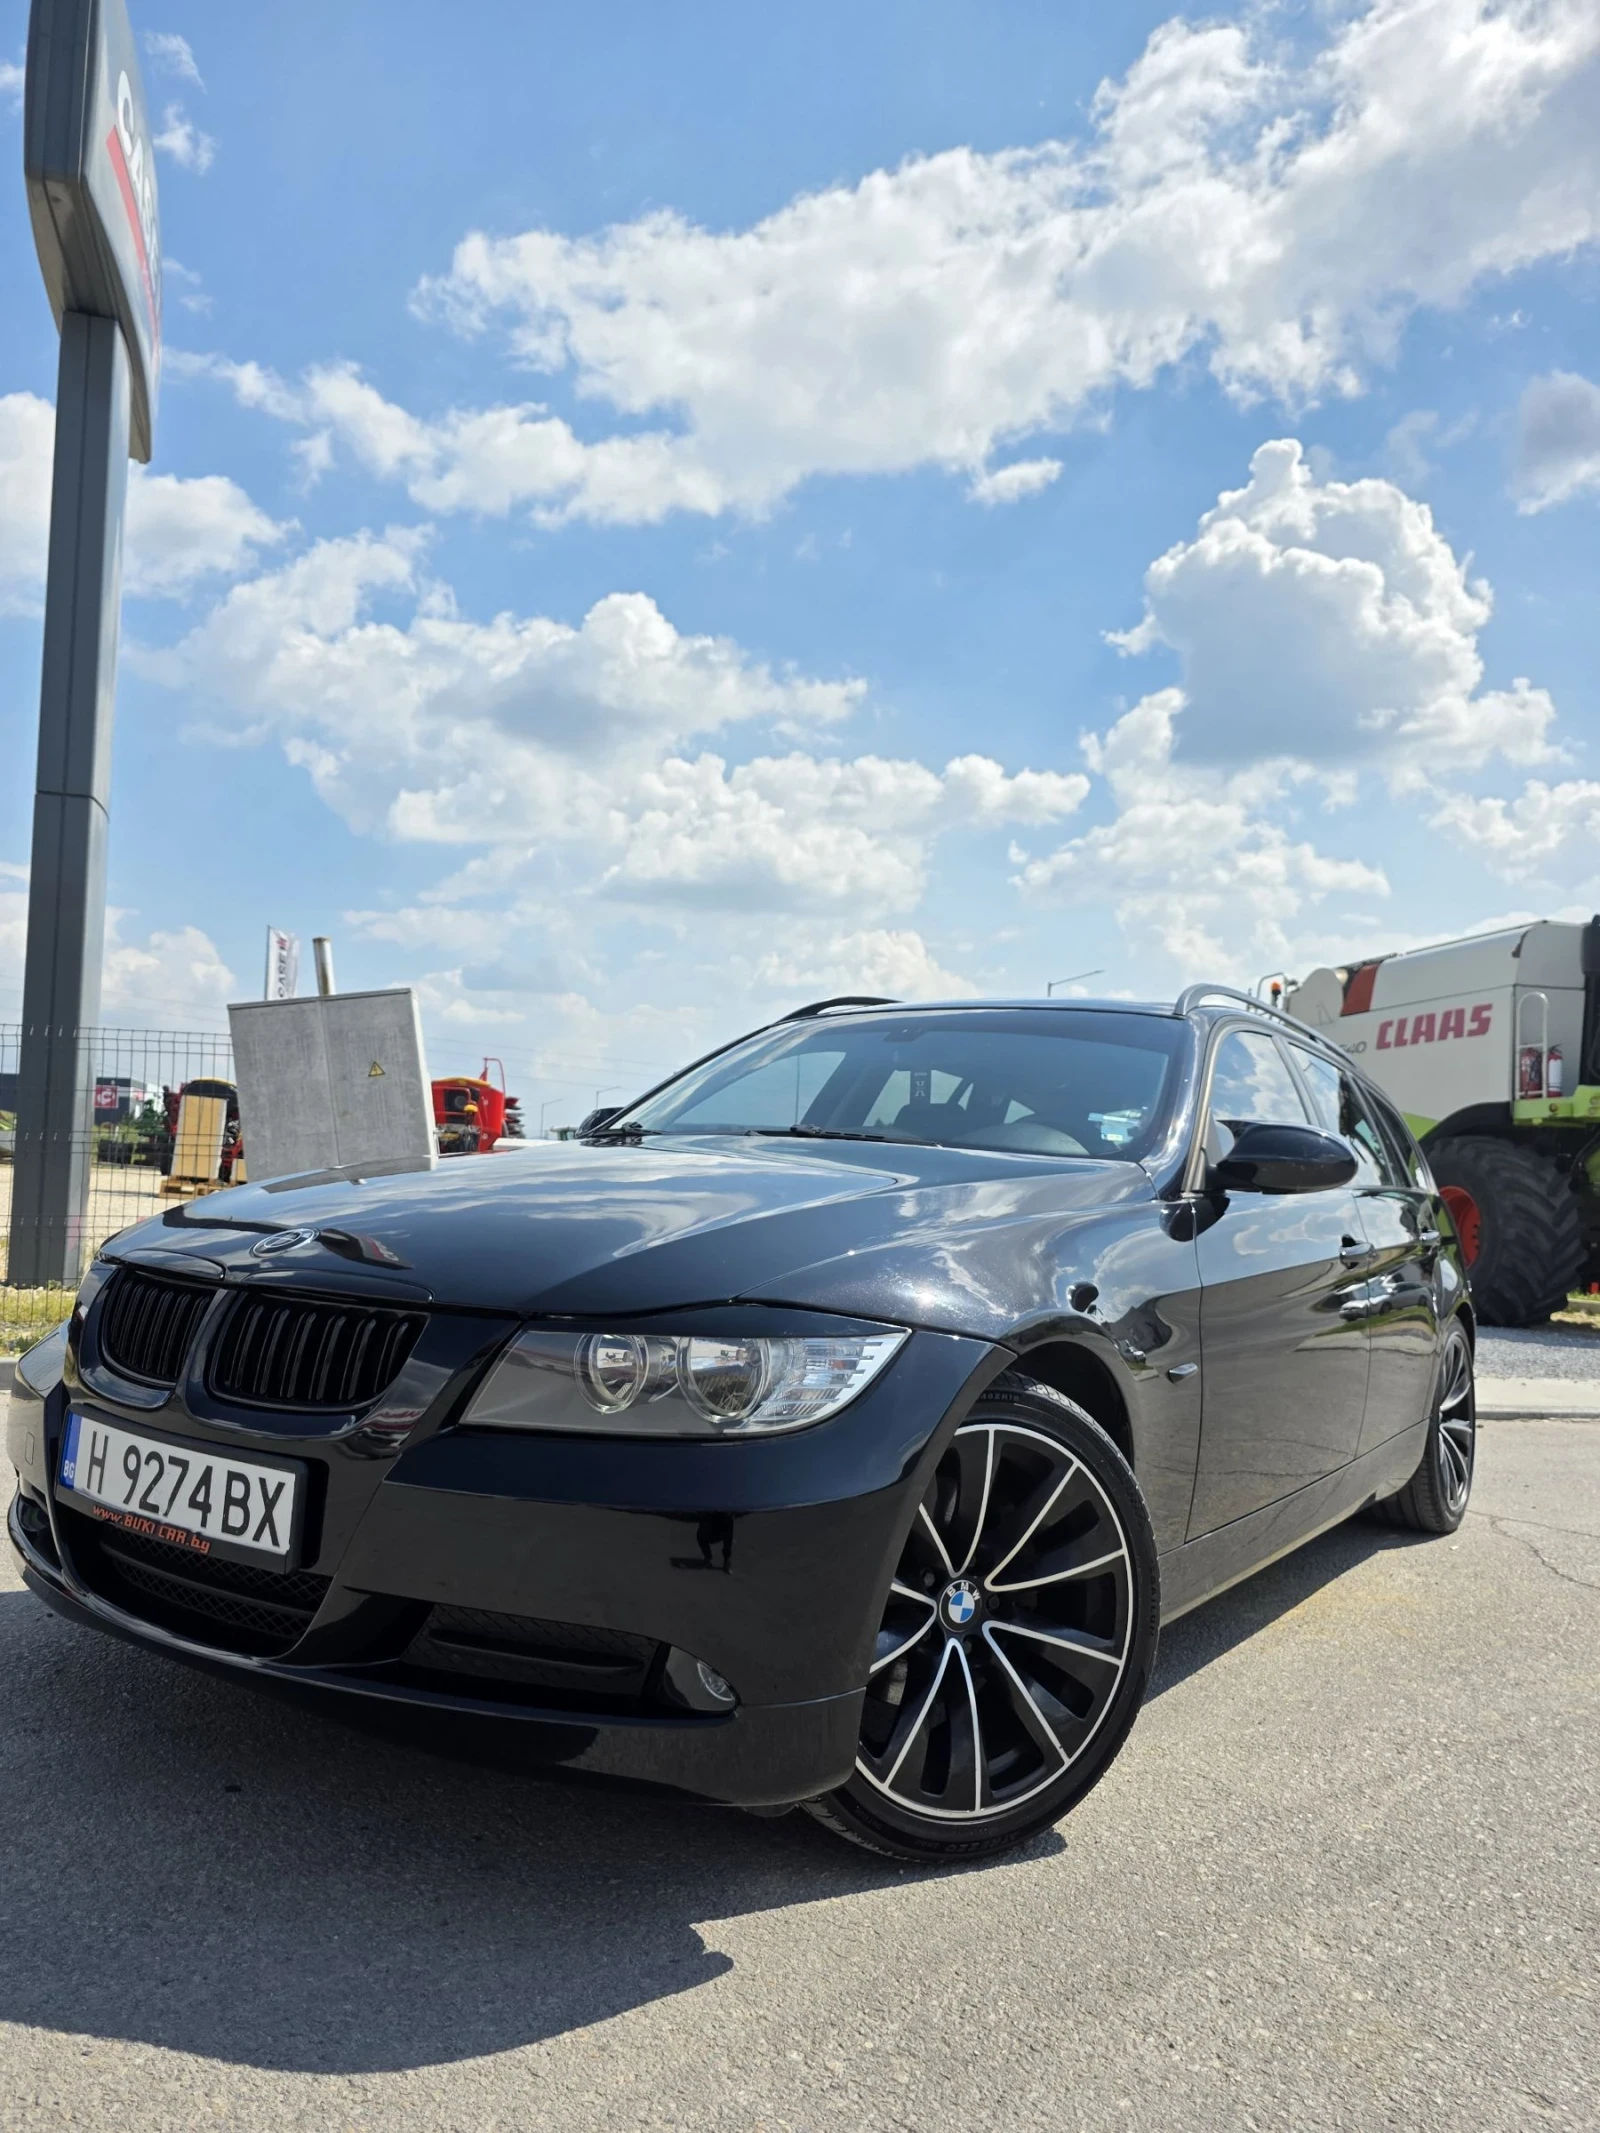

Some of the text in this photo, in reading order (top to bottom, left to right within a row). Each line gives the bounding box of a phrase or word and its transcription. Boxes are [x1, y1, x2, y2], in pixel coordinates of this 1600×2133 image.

[1375, 1003, 1493, 1050] CLAAS
[63, 1459, 75, 1480] BG
[86, 1430, 109, 1495] H
[946, 1581, 981, 1601] BMW
